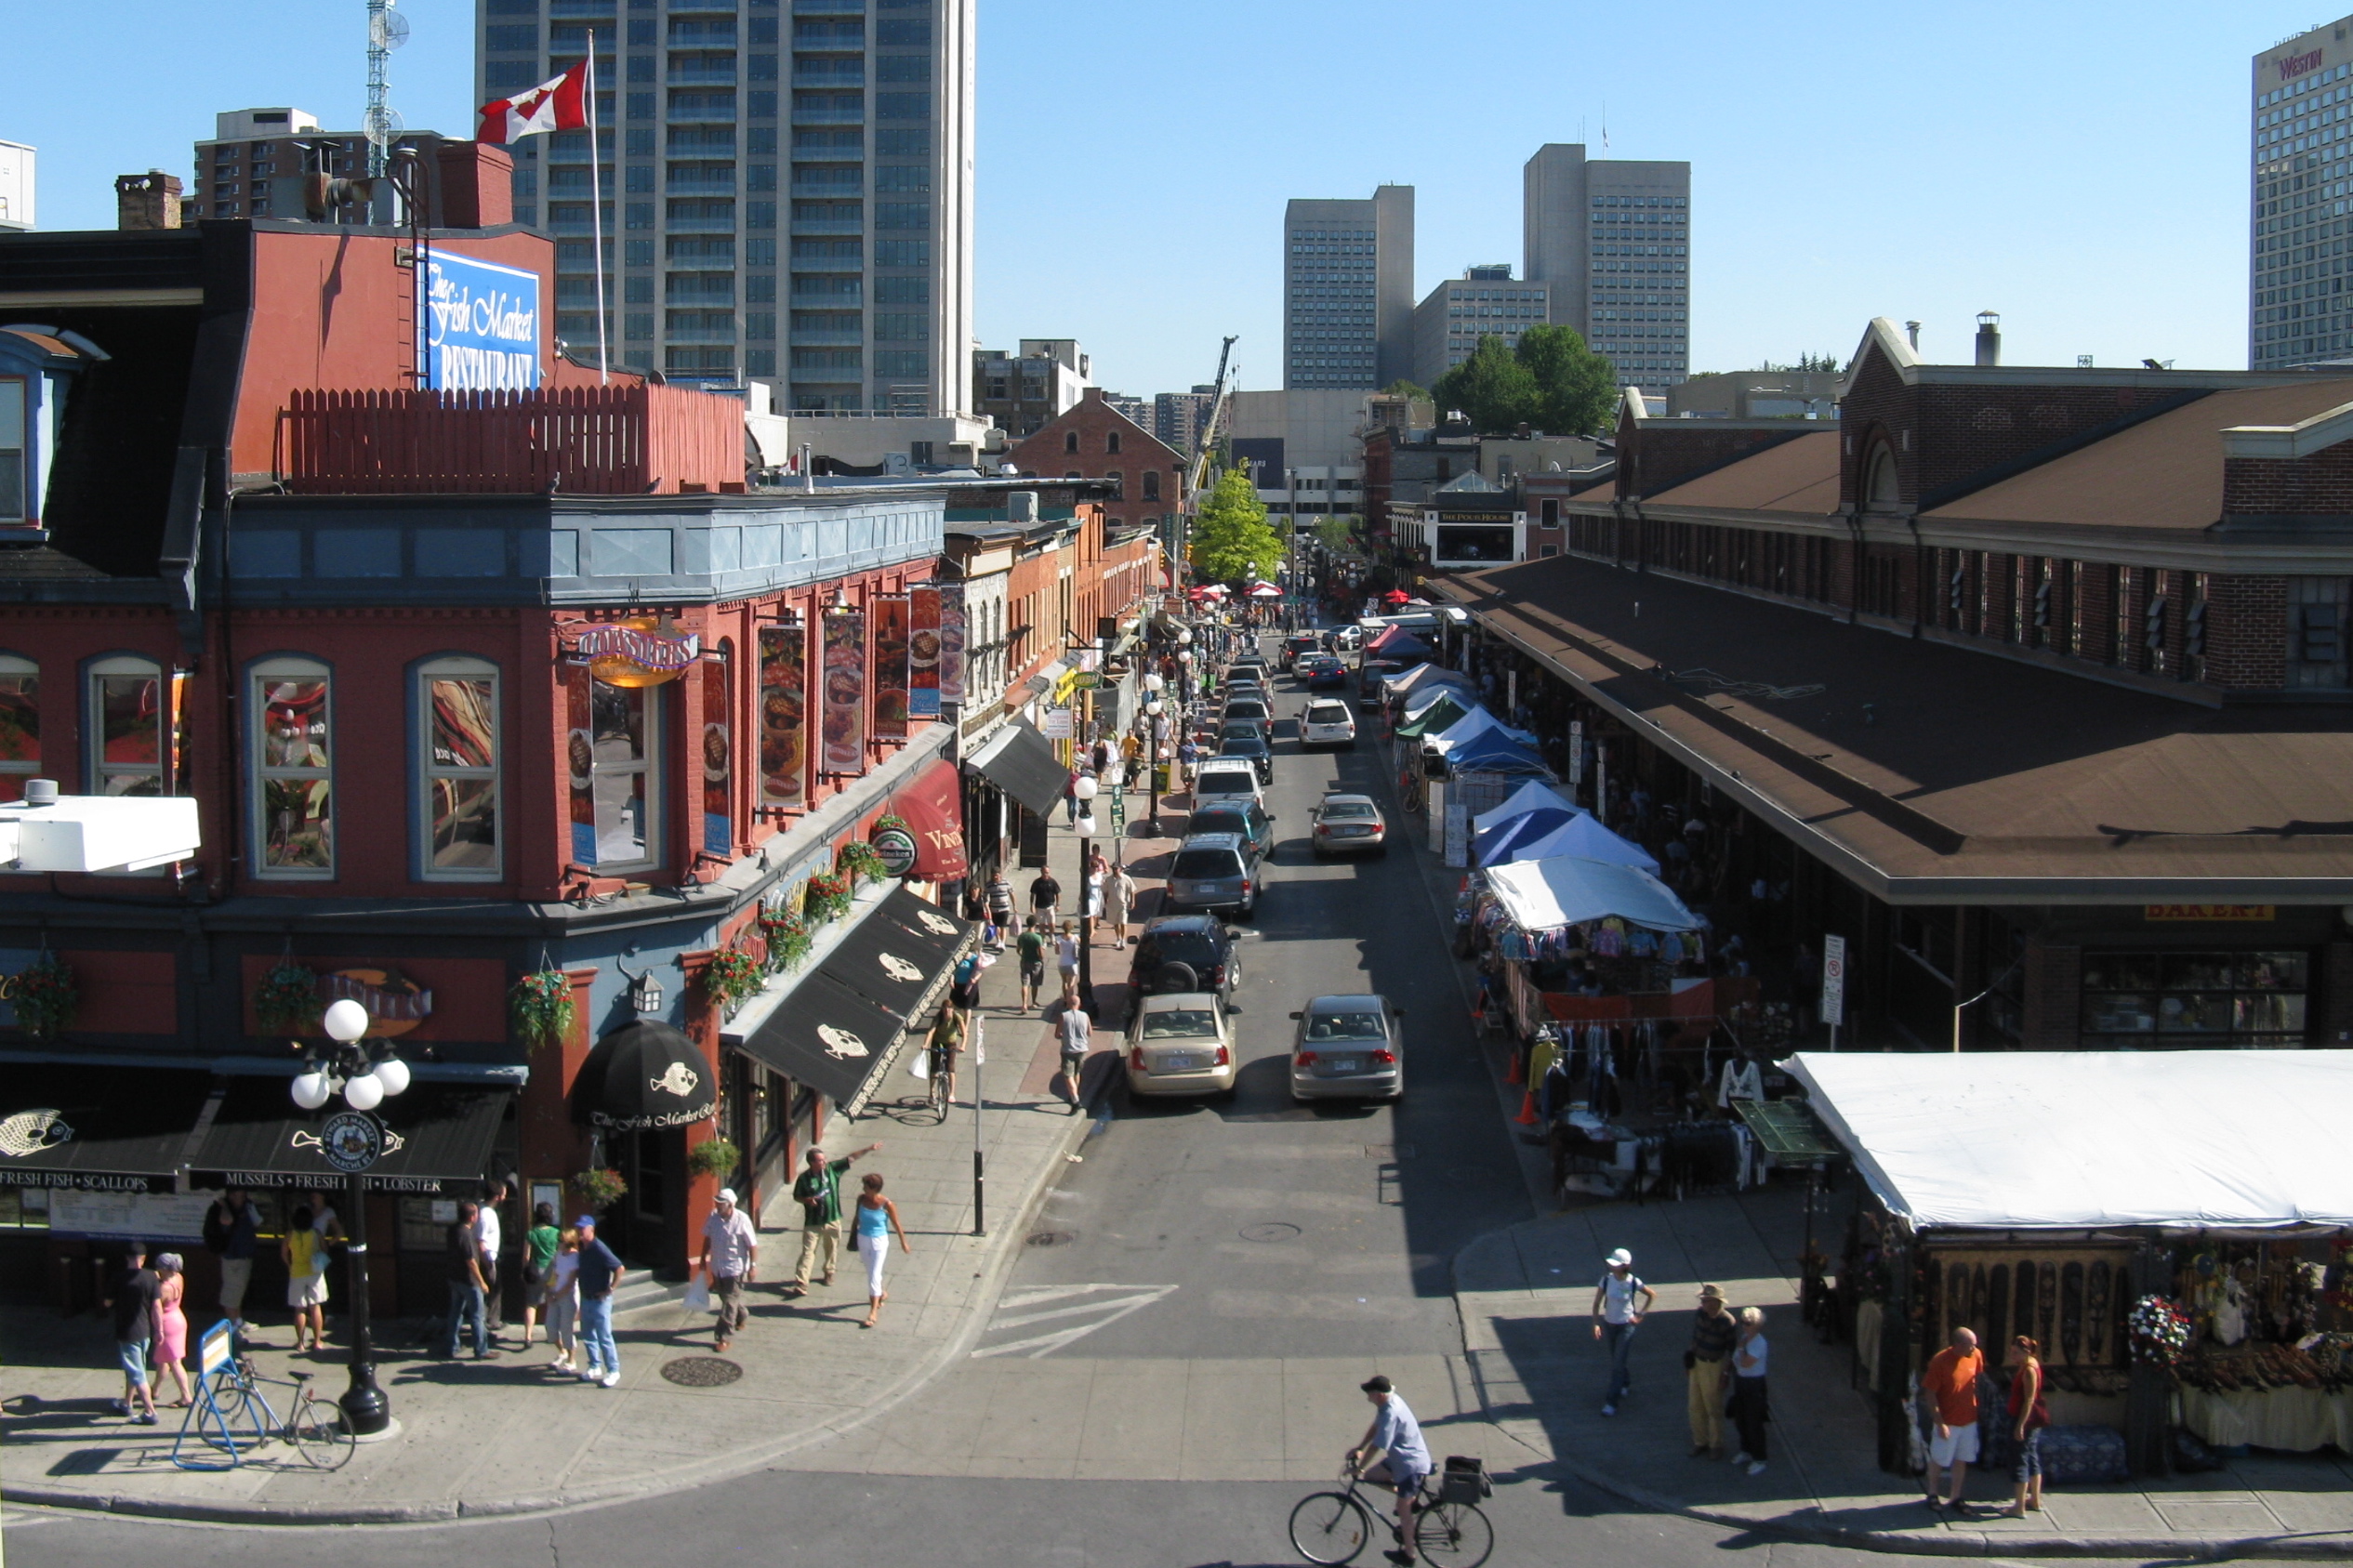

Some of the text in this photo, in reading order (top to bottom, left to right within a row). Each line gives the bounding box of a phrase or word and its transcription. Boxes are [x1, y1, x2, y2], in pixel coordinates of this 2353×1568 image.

[2280, 48, 2322, 81] WESTIN
[429, 282, 534, 347] Fish Market
[440, 345, 534, 398] RESTAURANT
[1075, 674, 1100, 684] LUSH
[350, 1116, 376, 1141] MARKET
[590, 1111, 615, 1126] The
[615, 1115, 652, 1131] Fish
[654, 1109, 698, 1127] Market
[0, 1172, 148, 1191] FRESH FISH SCALLOPS
[226, 1172, 284, 1187] MUSSELS
[296, 1175, 338, 1189] FRESH
[383, 1178, 442, 1192] LOBSTER
